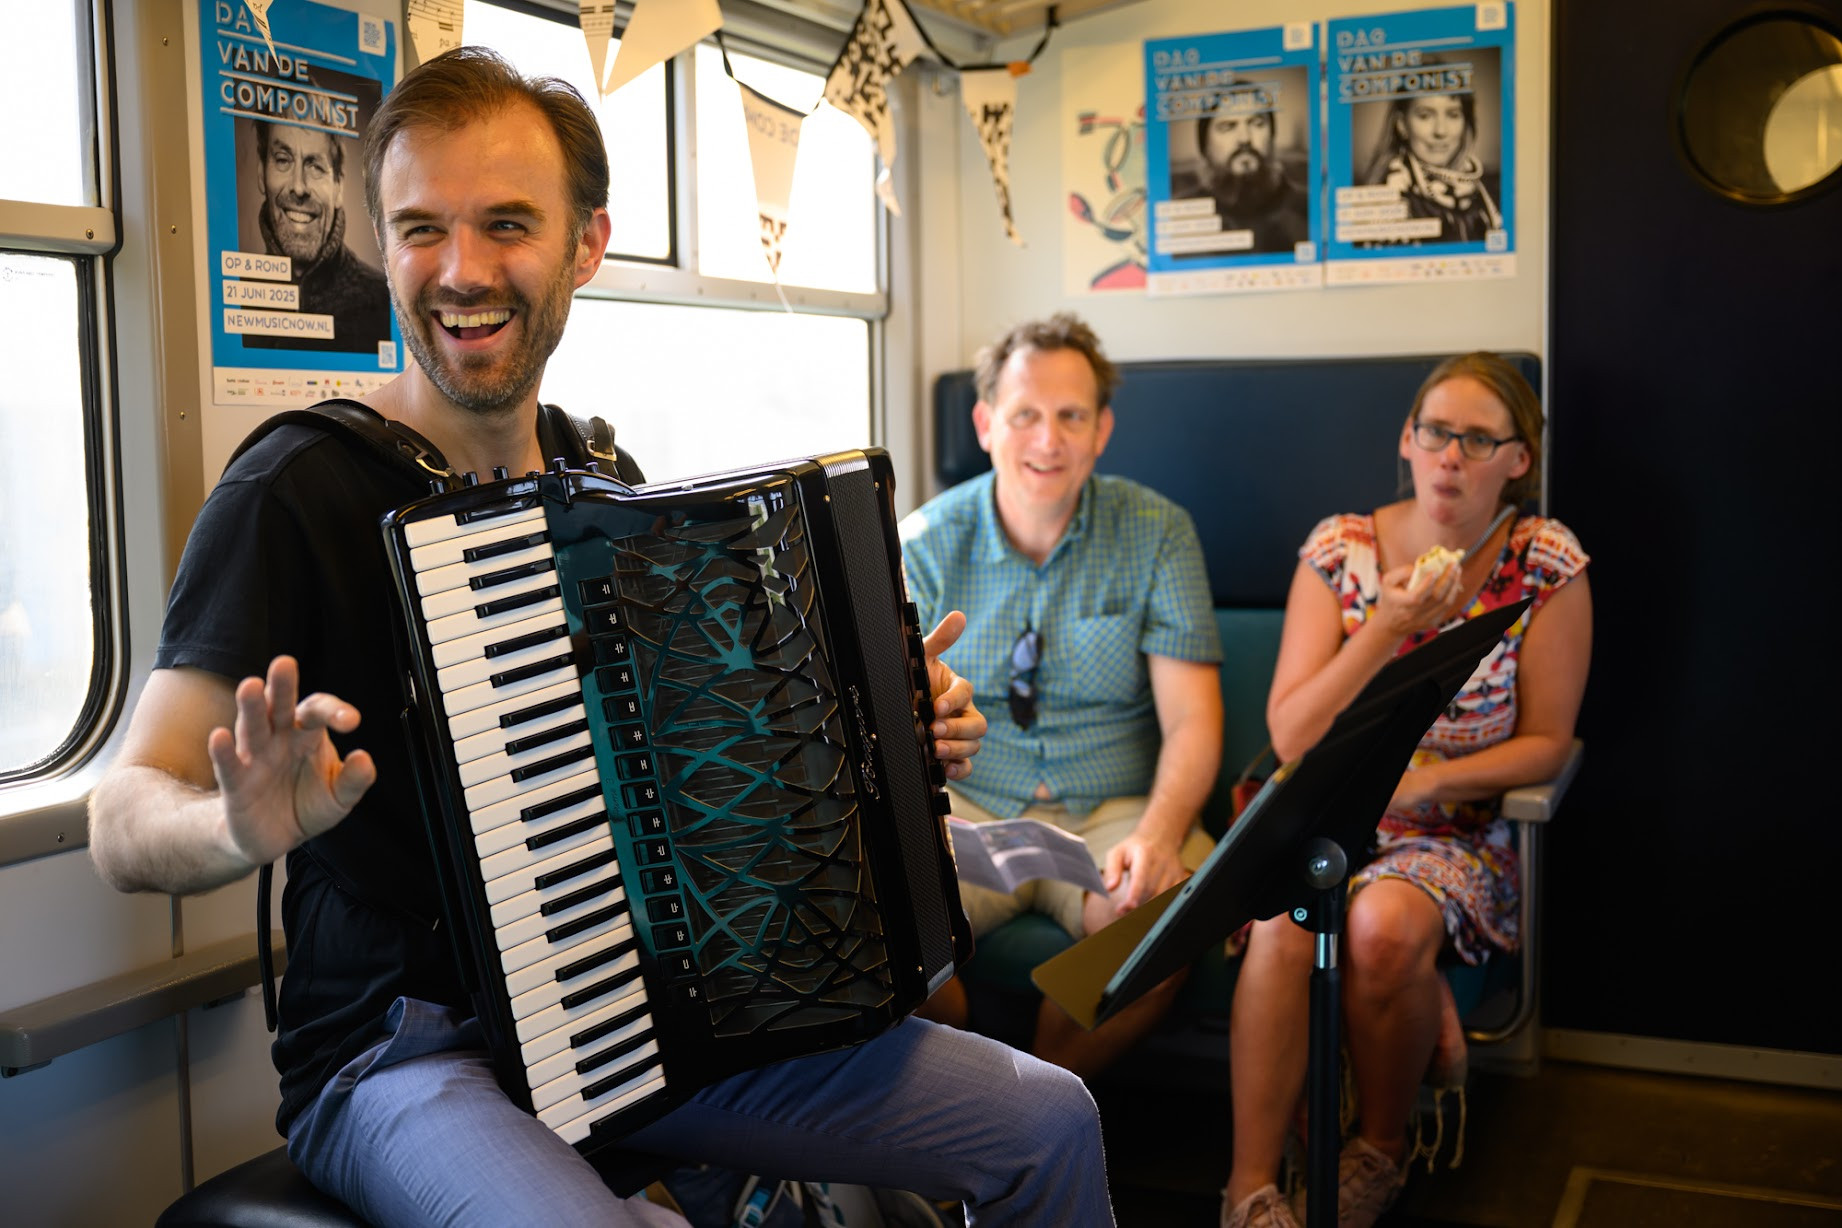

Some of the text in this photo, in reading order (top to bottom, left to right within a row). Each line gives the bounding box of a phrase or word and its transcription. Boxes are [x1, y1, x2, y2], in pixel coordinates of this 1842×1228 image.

[1336, 28, 1386, 48] DAG
[217, 40, 310, 82] VAN DE
[1153, 48, 1200, 67] DAG
[1337, 50, 1423, 73] VAN DE
[1338, 70, 1474, 97] COMPONIST
[220, 81, 359, 128] COMPONIST
[1156, 89, 1282, 116] COMPONIST
[225, 256, 289, 274] OP & ROND
[226, 286, 296, 303] 21 JUNI 2025
[227, 315, 331, 332] NEWMUSICNOW.NL
